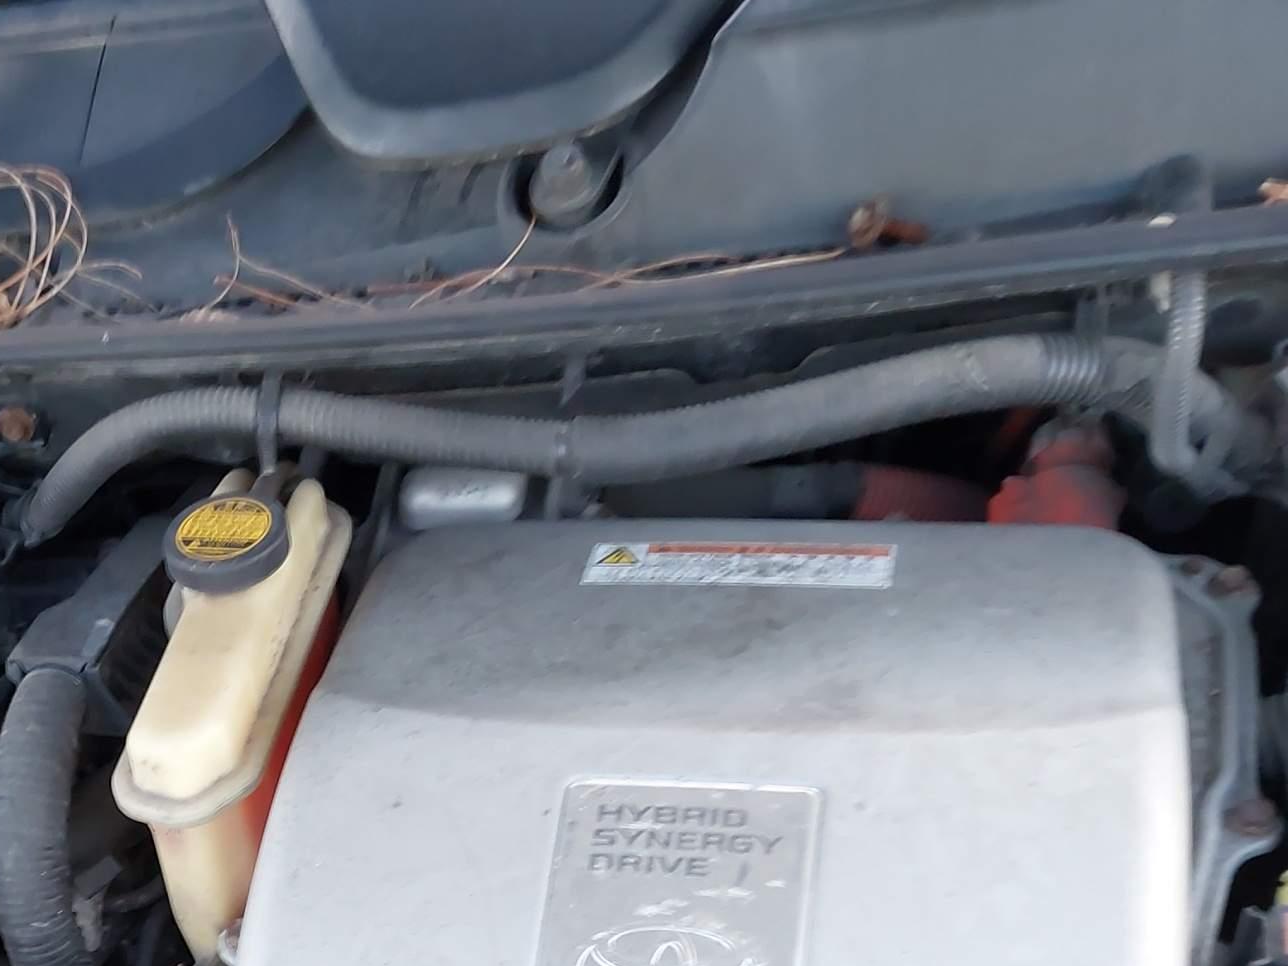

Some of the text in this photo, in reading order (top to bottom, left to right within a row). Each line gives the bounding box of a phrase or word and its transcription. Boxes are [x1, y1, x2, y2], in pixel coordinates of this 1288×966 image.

[596, 803, 749, 828] HYBRID
[591, 827, 784, 854] SYNERGY
[587, 852, 710, 877] DRIVE
